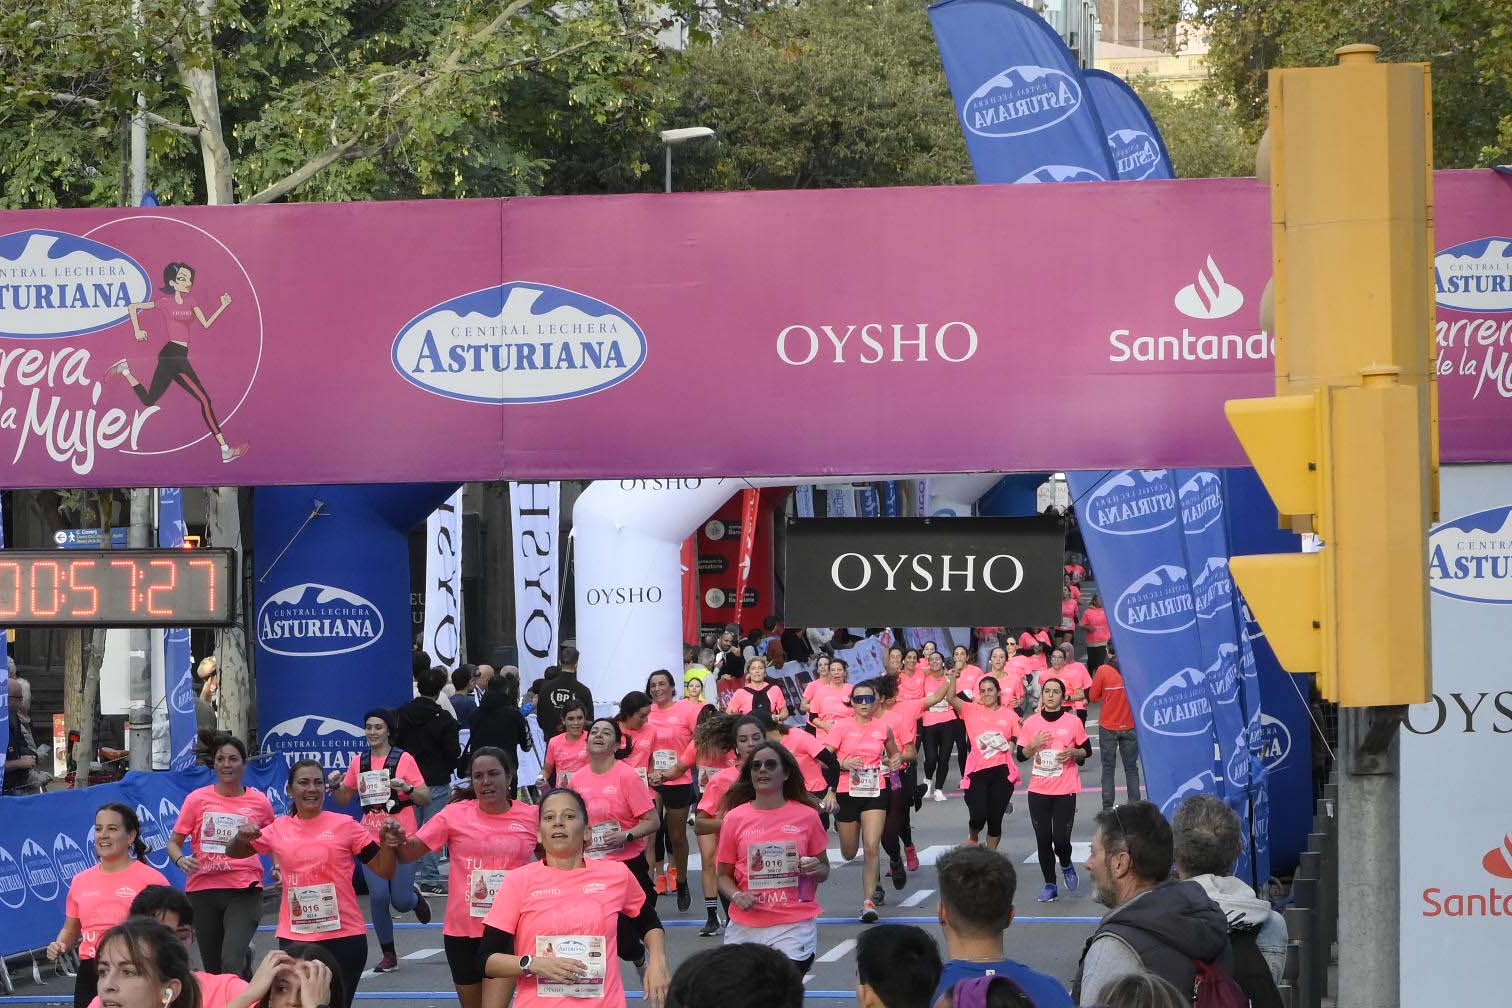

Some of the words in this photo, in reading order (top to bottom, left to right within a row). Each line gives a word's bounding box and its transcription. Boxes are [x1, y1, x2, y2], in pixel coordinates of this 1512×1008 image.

[54, 265, 128, 278] LECHERA
[450, 323, 530, 337] CENTRAL
[537, 321, 619, 335] LECHERA
[411, 329, 628, 375] ASTURIANA
[776, 321, 979, 366] OYSHO
[1108, 327, 1275, 363] Santand
[1459, 348, 1477, 376] la
[12, 381, 161, 475] Mujer
[830, 552, 1024, 594] OYSHO
[586, 586, 663, 606] OYSHO
[274, 609, 319, 617] CENTRAL
[322, 608, 371, 617] LECHERA
[261, 617, 375, 642] ASTURIANA
[276, 740, 317, 749] CENTRAL
[216, 828, 232, 836] 016
[466, 858, 482, 870] TU
[765, 859, 783, 867] 016
[303, 904, 319, 913] 016
